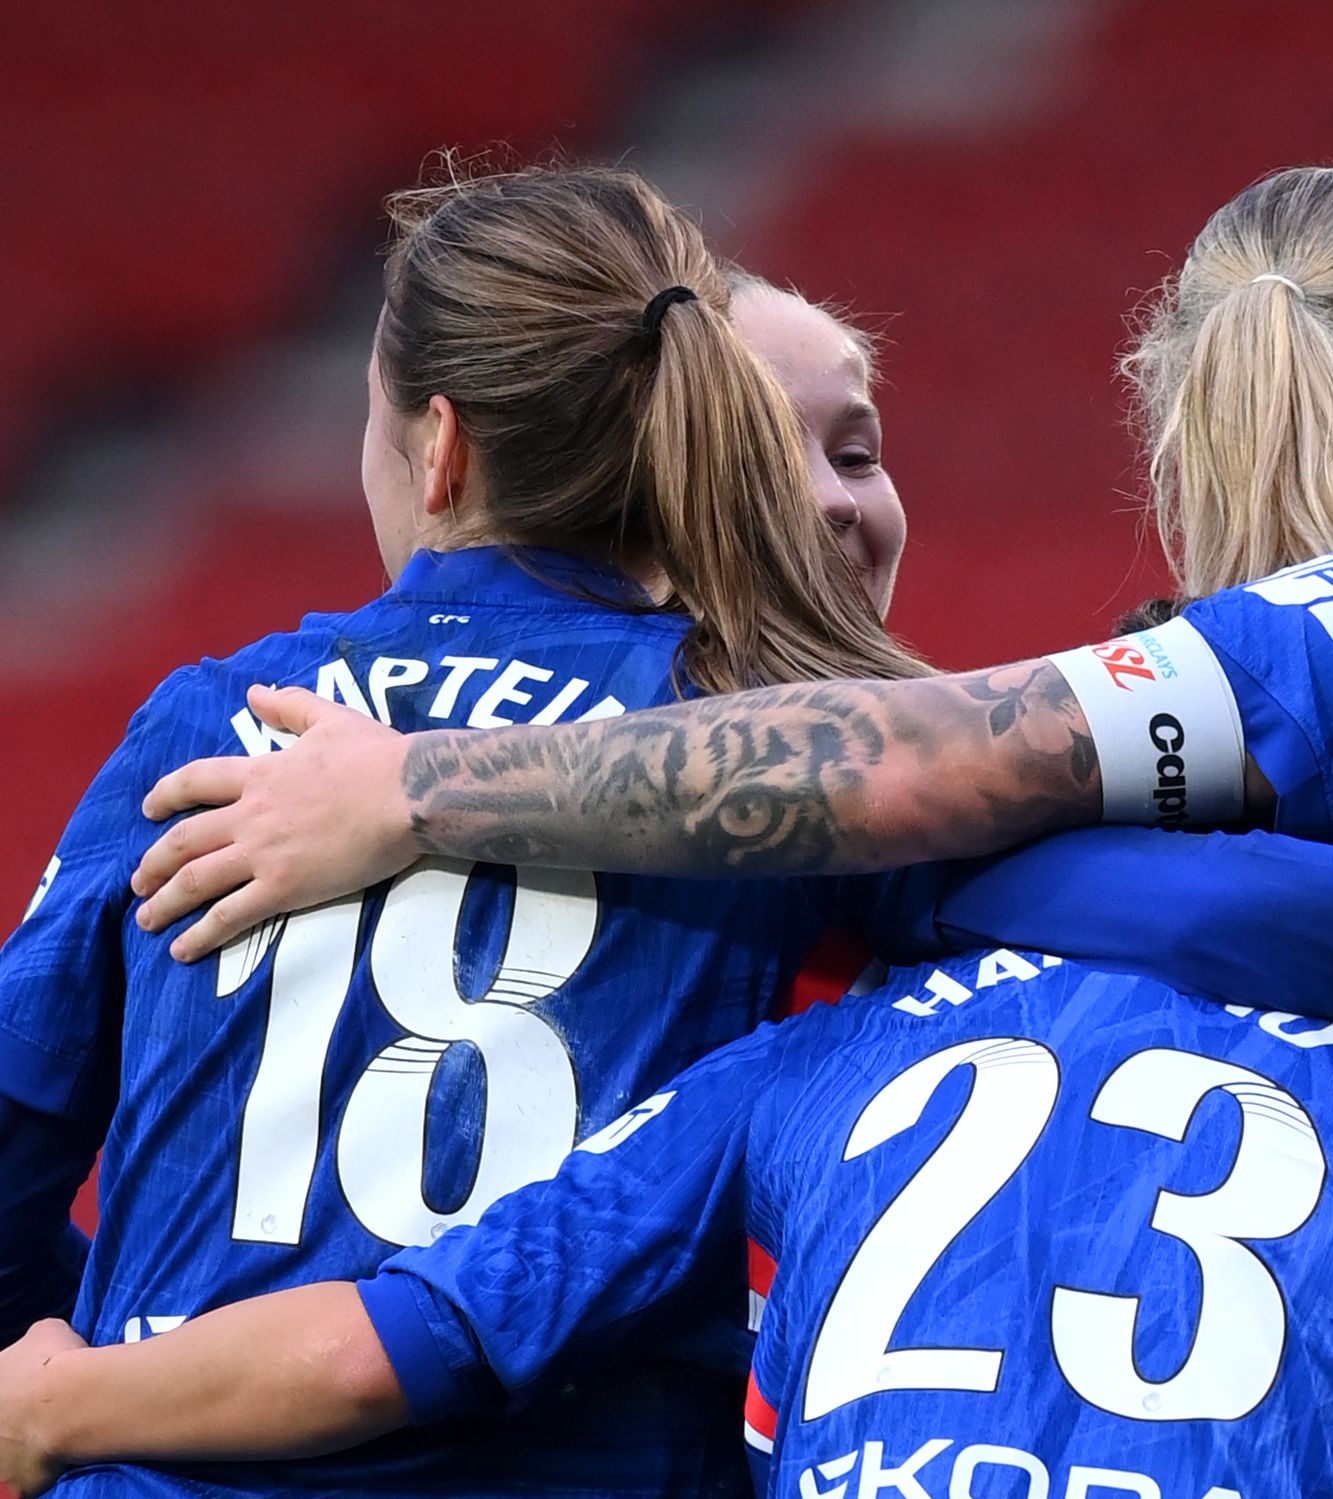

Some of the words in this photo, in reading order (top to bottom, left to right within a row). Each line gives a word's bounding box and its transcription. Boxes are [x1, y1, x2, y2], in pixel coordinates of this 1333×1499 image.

[1092, 638, 1156, 692] SL
[1135, 631, 1178, 680] RCLAYS
[216, 858, 599, 1248] 18
[801, 1037, 1328, 1422] 23
